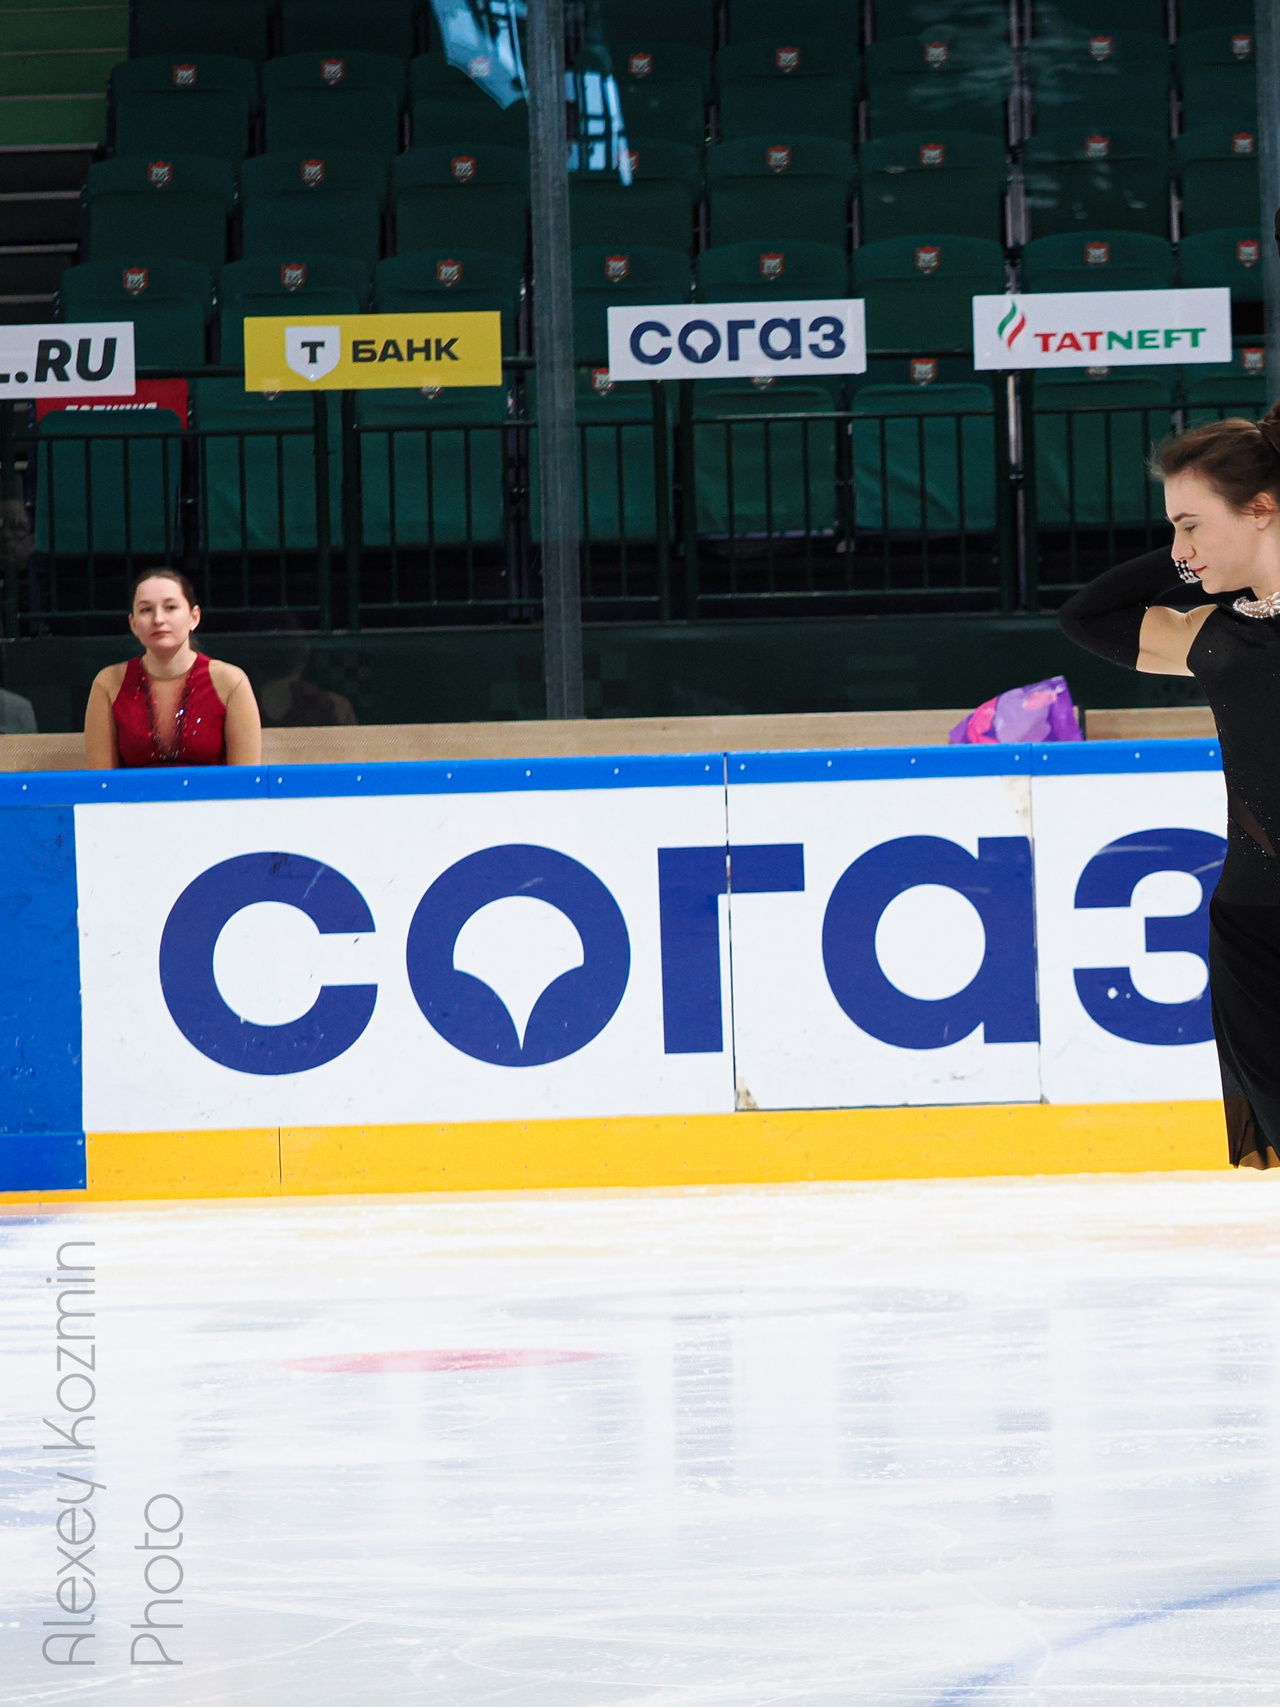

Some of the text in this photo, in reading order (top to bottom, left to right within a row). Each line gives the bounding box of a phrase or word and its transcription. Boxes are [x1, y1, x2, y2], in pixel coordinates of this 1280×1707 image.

[352, 337, 461, 363] БАНК
[1034, 328, 1207, 352] TATNEFT
[0, 337, 117, 384] .RU
